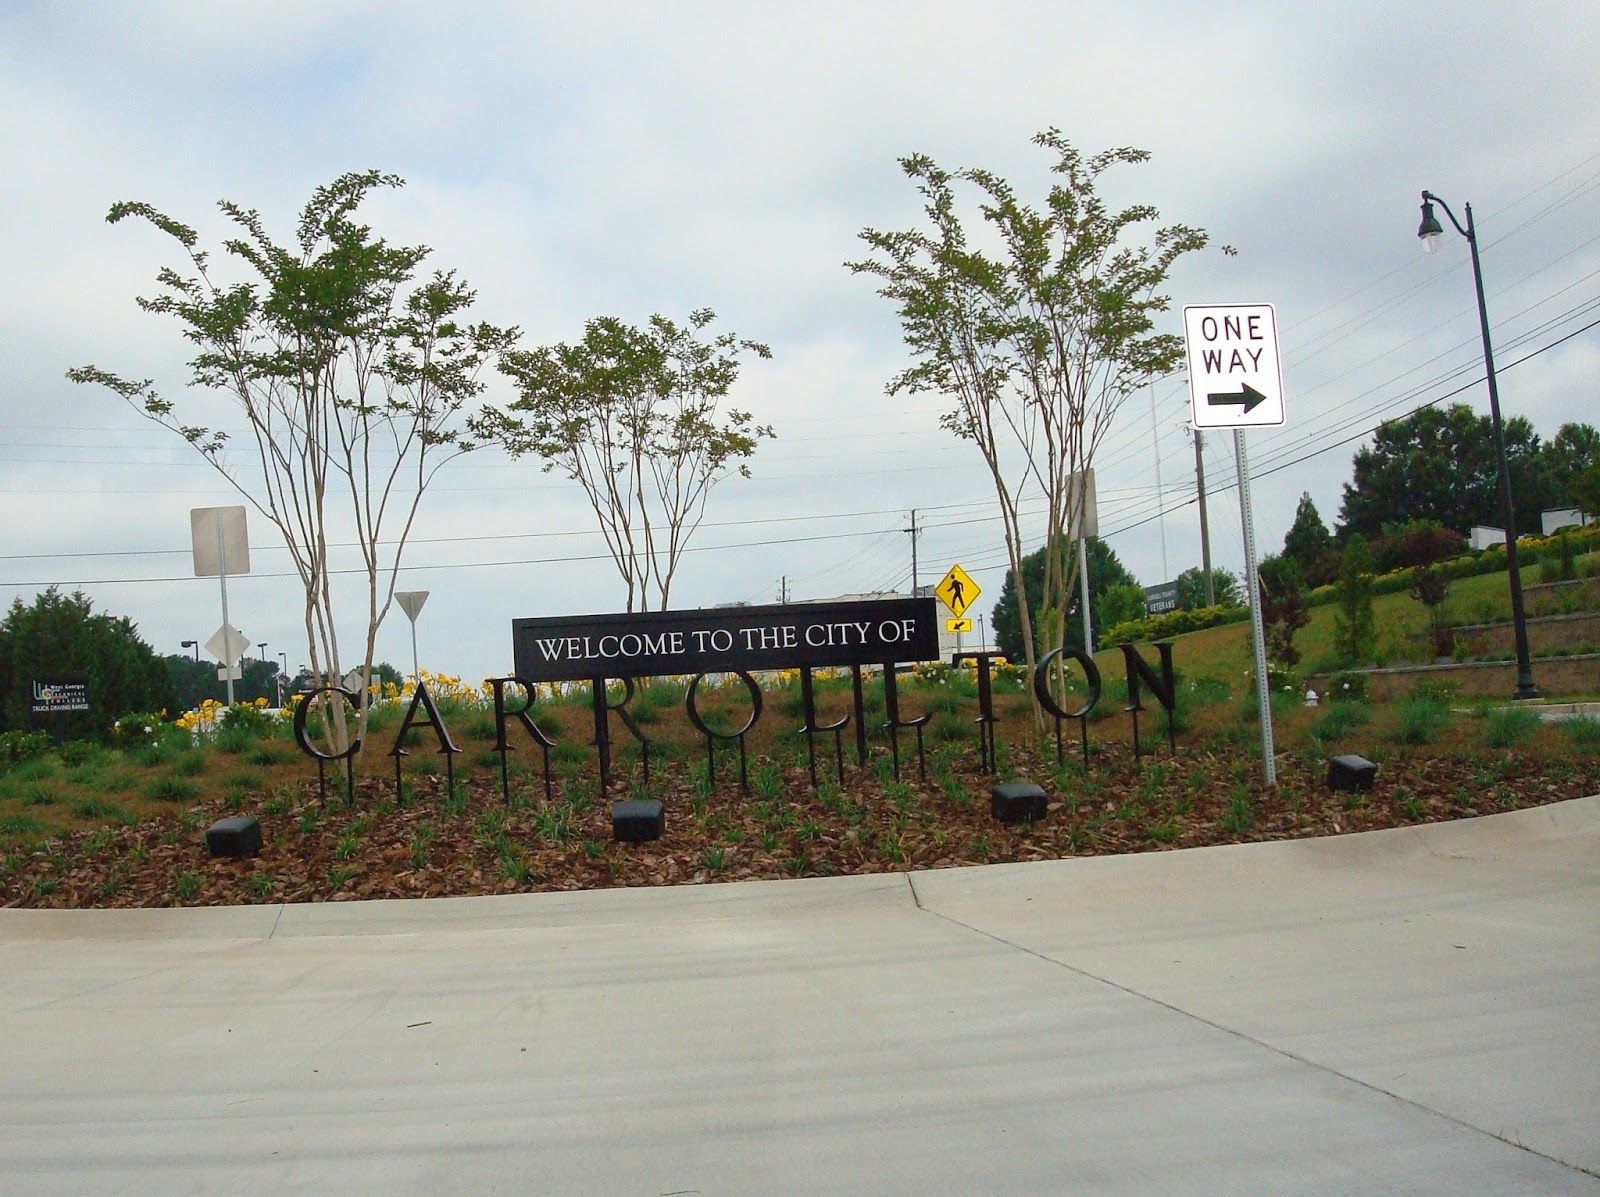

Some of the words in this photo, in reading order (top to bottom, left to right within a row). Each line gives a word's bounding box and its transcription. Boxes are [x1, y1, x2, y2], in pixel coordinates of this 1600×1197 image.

[1202, 316, 1264, 341] ONE
[1202, 347, 1263, 374] WAY
[535, 632, 686, 662] WELCOME
[691, 629, 733, 653] TO
[739, 626, 798, 650] THE
[805, 622, 872, 647] CITY
[878, 619, 916, 643] OF
[294, 643, 1176, 761] CARROLLTON
